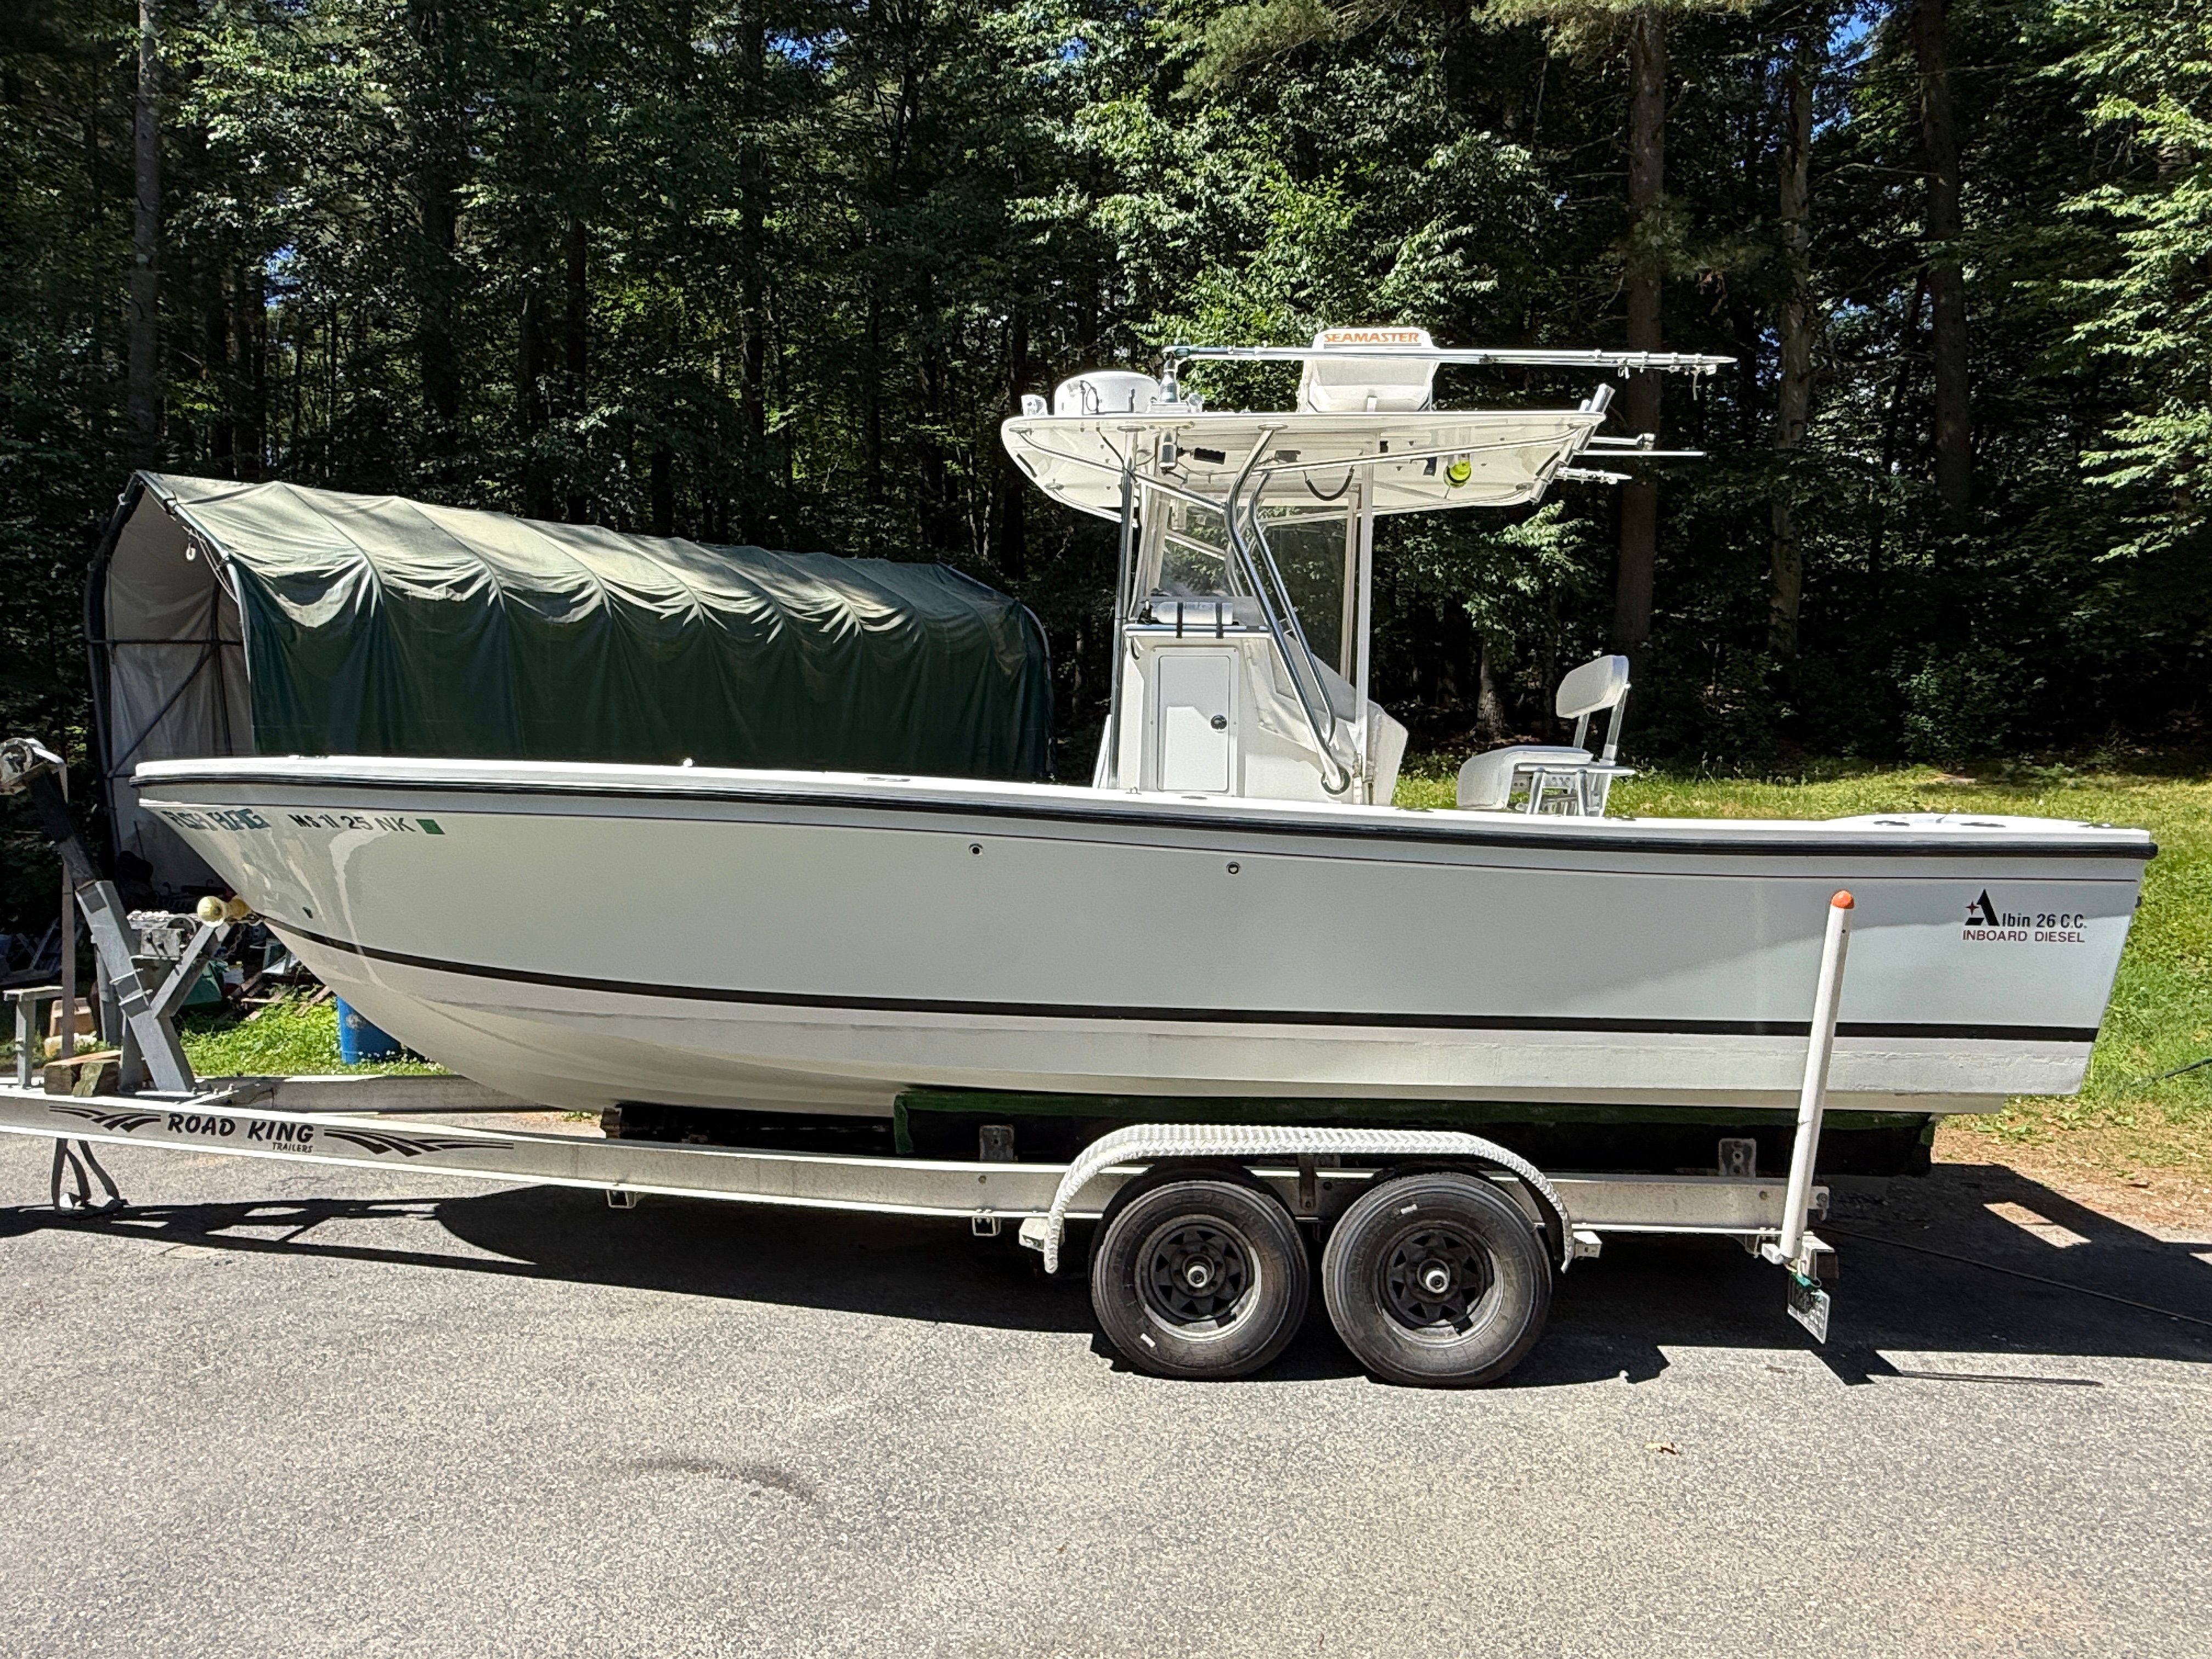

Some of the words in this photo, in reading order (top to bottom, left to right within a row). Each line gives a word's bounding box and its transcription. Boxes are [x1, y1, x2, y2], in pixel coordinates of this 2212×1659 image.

[1324, 332, 1419, 342] SEAMASTER
[374, 817, 416, 832] NK
[2036, 913, 2056, 928] 26
[1962, 929, 2028, 942] INBOARD
[2034, 931, 2085, 943] DIESEL
[167, 1113, 236, 1137] ROAD
[247, 1120, 314, 1143] KING
[272, 1142, 313, 1153] TRAILERS
